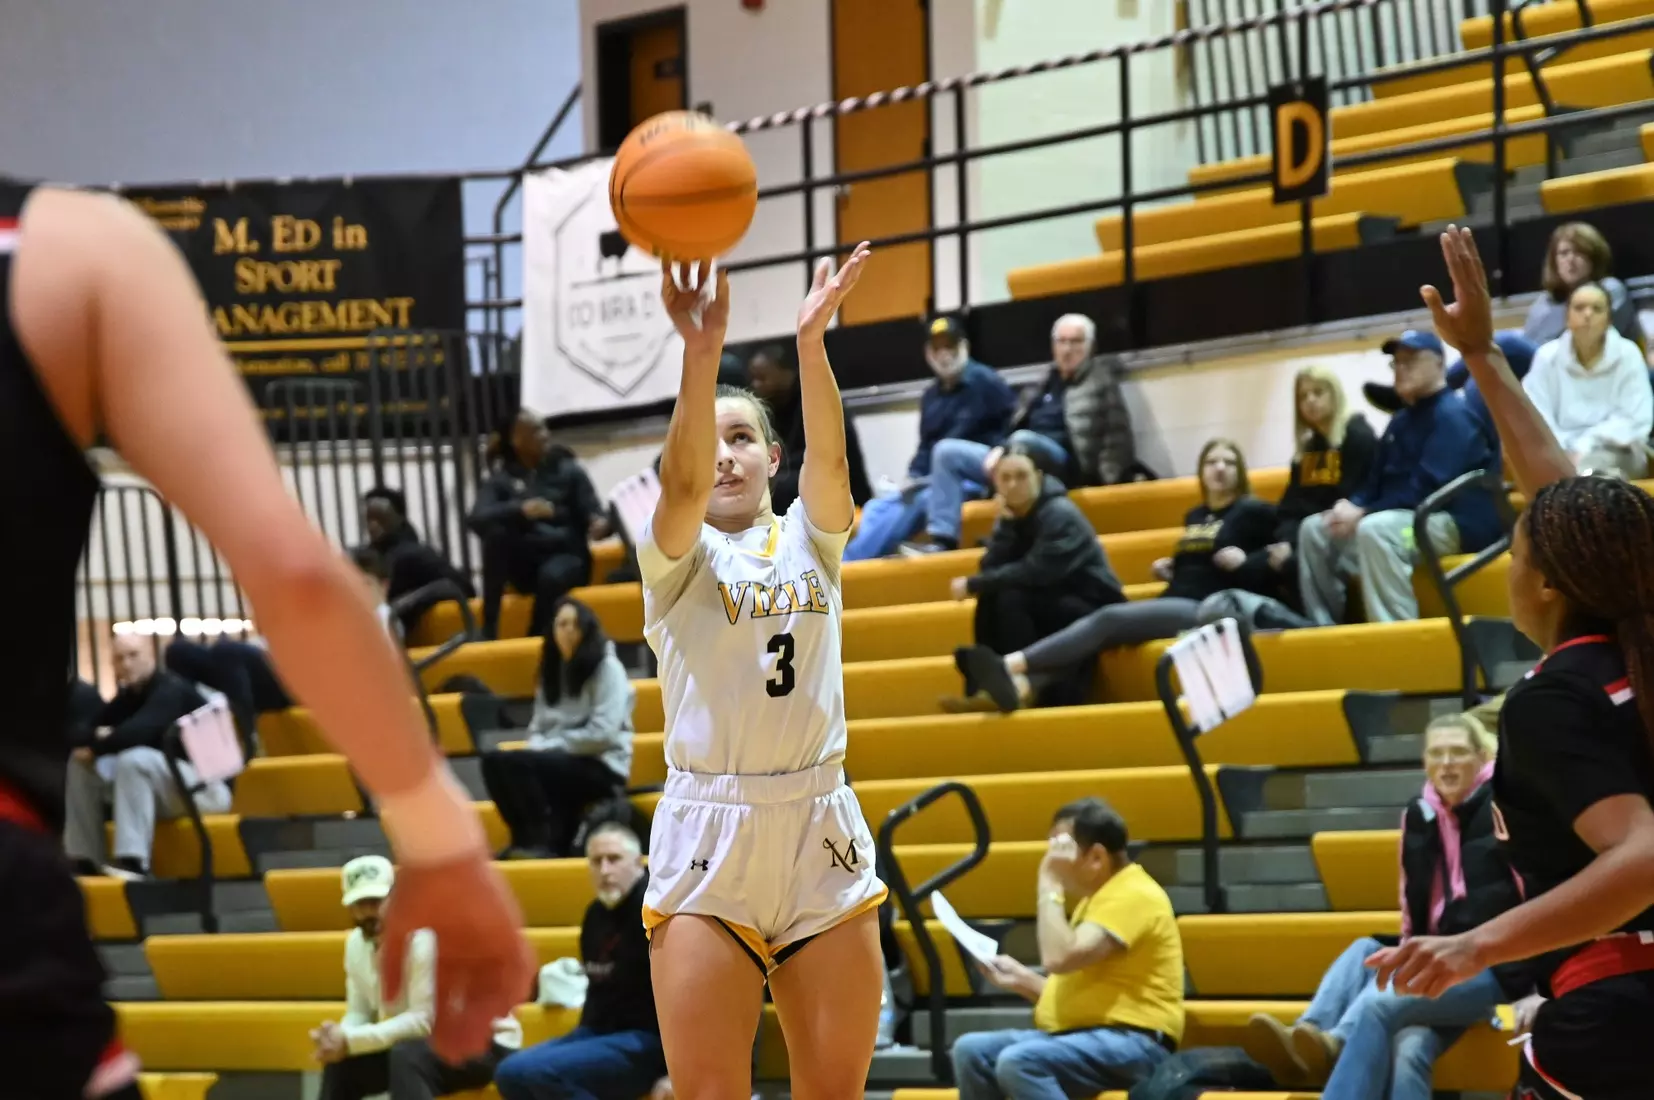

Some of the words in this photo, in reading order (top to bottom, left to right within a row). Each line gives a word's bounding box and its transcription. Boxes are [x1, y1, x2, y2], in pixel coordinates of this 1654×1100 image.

[1277, 101, 1324, 188] D
[212, 216, 261, 254] M.
[332, 215, 368, 250] in
[234, 257, 342, 294] SPORT
[213, 297, 415, 336] ANAGEMENT
[717, 568, 830, 625] VILLE
[766, 632, 795, 697] 3
